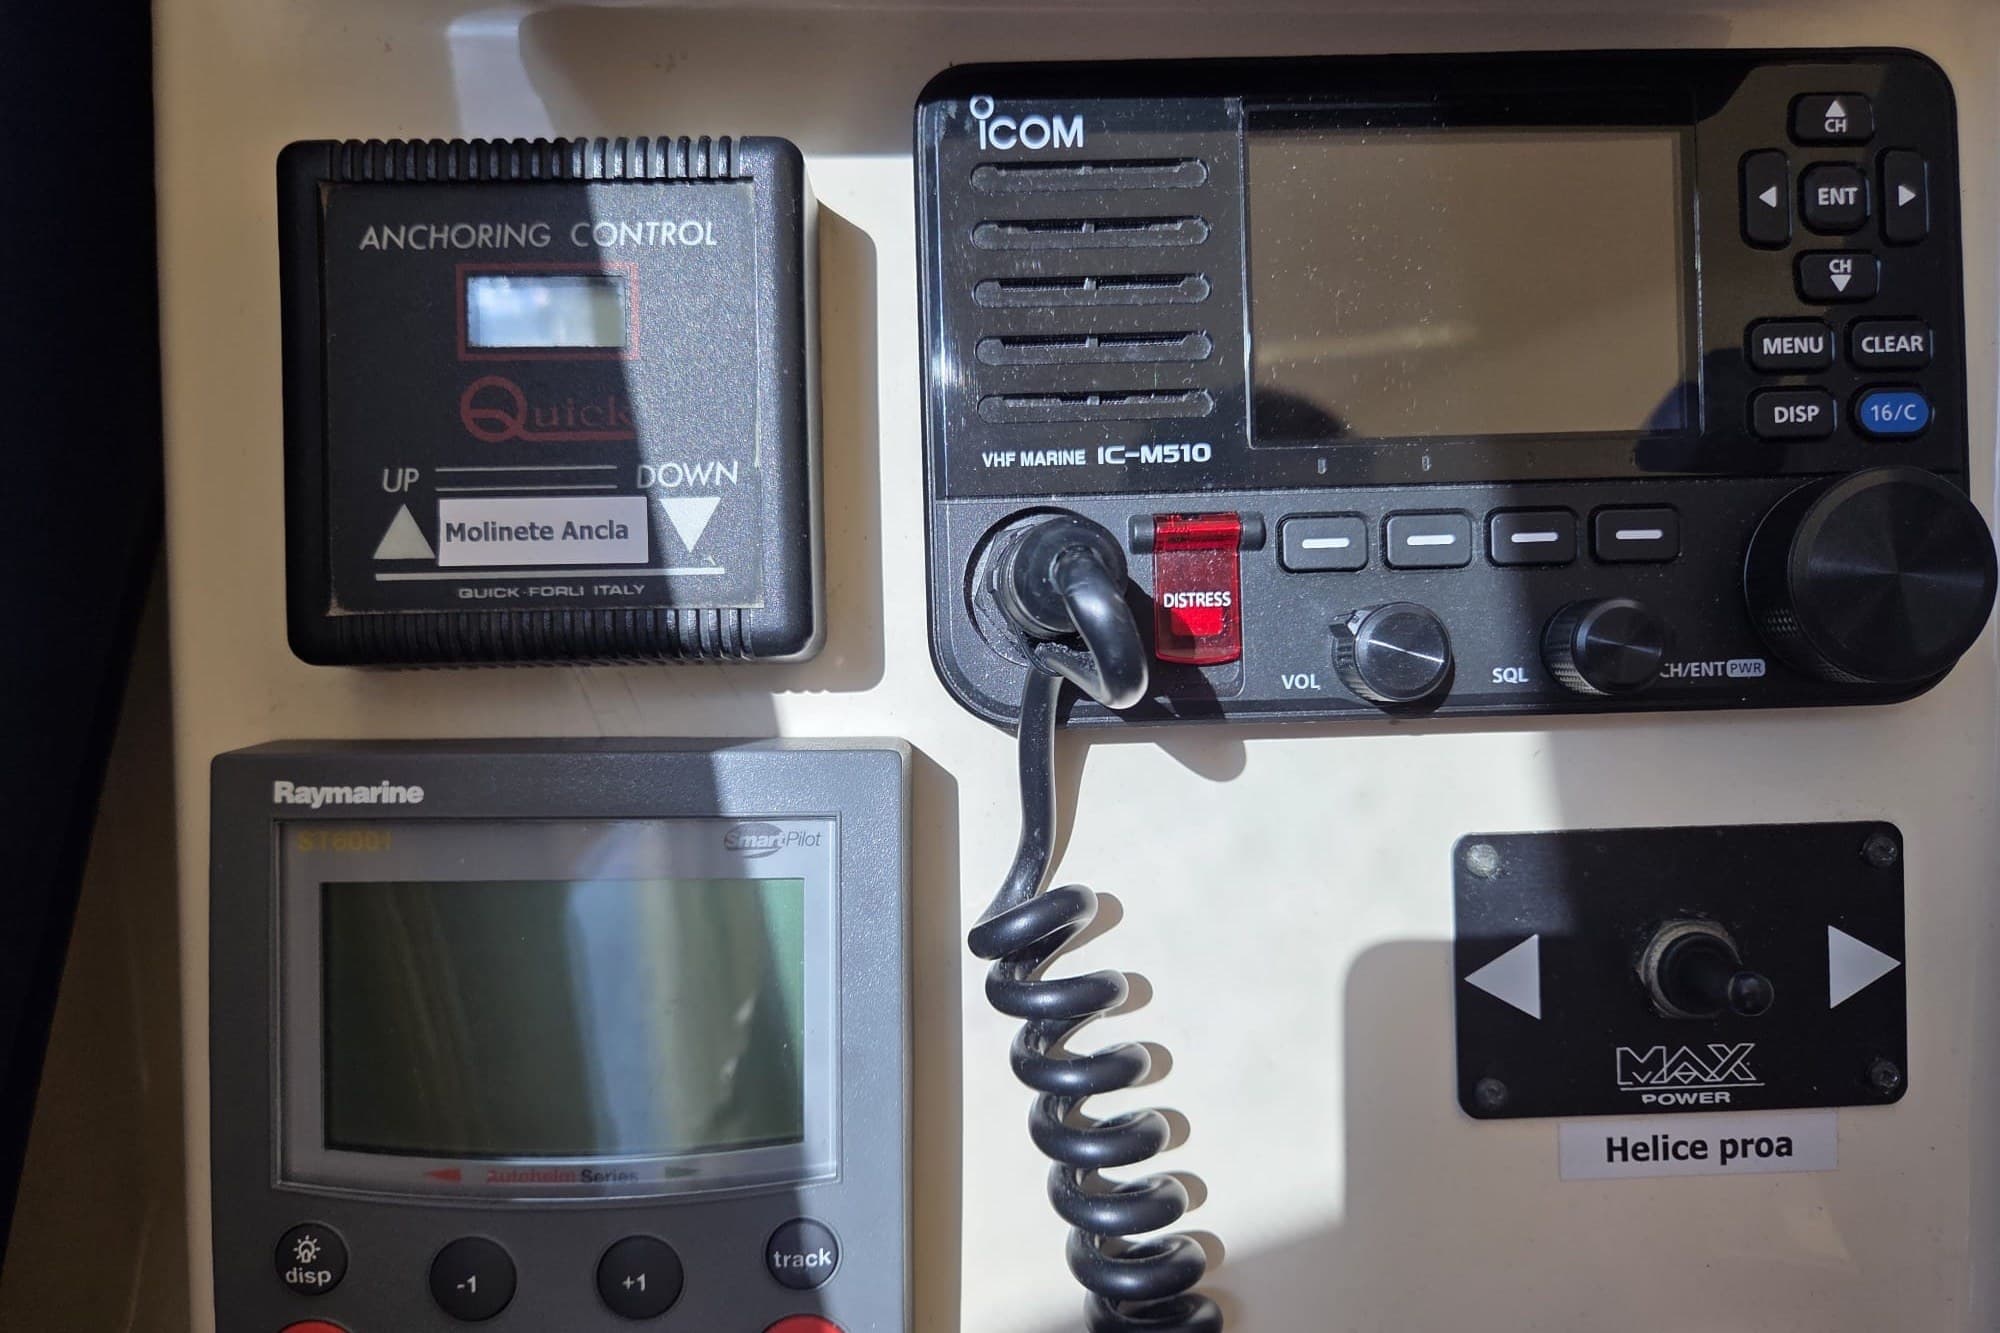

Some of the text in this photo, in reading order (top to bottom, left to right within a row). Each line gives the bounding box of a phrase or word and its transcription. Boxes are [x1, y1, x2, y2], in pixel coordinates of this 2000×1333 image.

[1823, 118, 1848, 133] CH
[1817, 187, 1859, 206] ENT
[360, 221, 718, 250] ANCHORING CONTROL
[1829, 259, 1852, 273] CH
[1762, 336, 1824, 355] MENU
[1861, 335, 1924, 353] CLEAR
[1774, 405, 1821, 424] DISP
[1870, 404, 1917, 421] 16/C
[982, 443, 1212, 469] VHF MARINE IC-M510
[382, 468, 420, 492] UP
[636, 461, 739, 489] DOWN
[446, 519, 629, 543] Molinete Ancla
[593, 584, 645, 596] ITALY
[1163, 591, 1232, 608] DISTRESS
[1492, 667, 1529, 684] SQL
[1729, 661, 1763, 675] PWR
[1281, 673, 1320, 690] VOL
[273, 780, 424, 808] Raymarine
[1615, 1043, 1757, 1086] MAX
[1641, 1090, 1732, 1105] POWER
[1606, 1133, 1795, 1166] Helice proa
[580, 1168, 639, 1183] Series
[773, 1246, 832, 1268] track
[285, 1266, 332, 1288] disp
[456, 1274, 478, 1293] -1
[621, 1274, 647, 1292] +1
